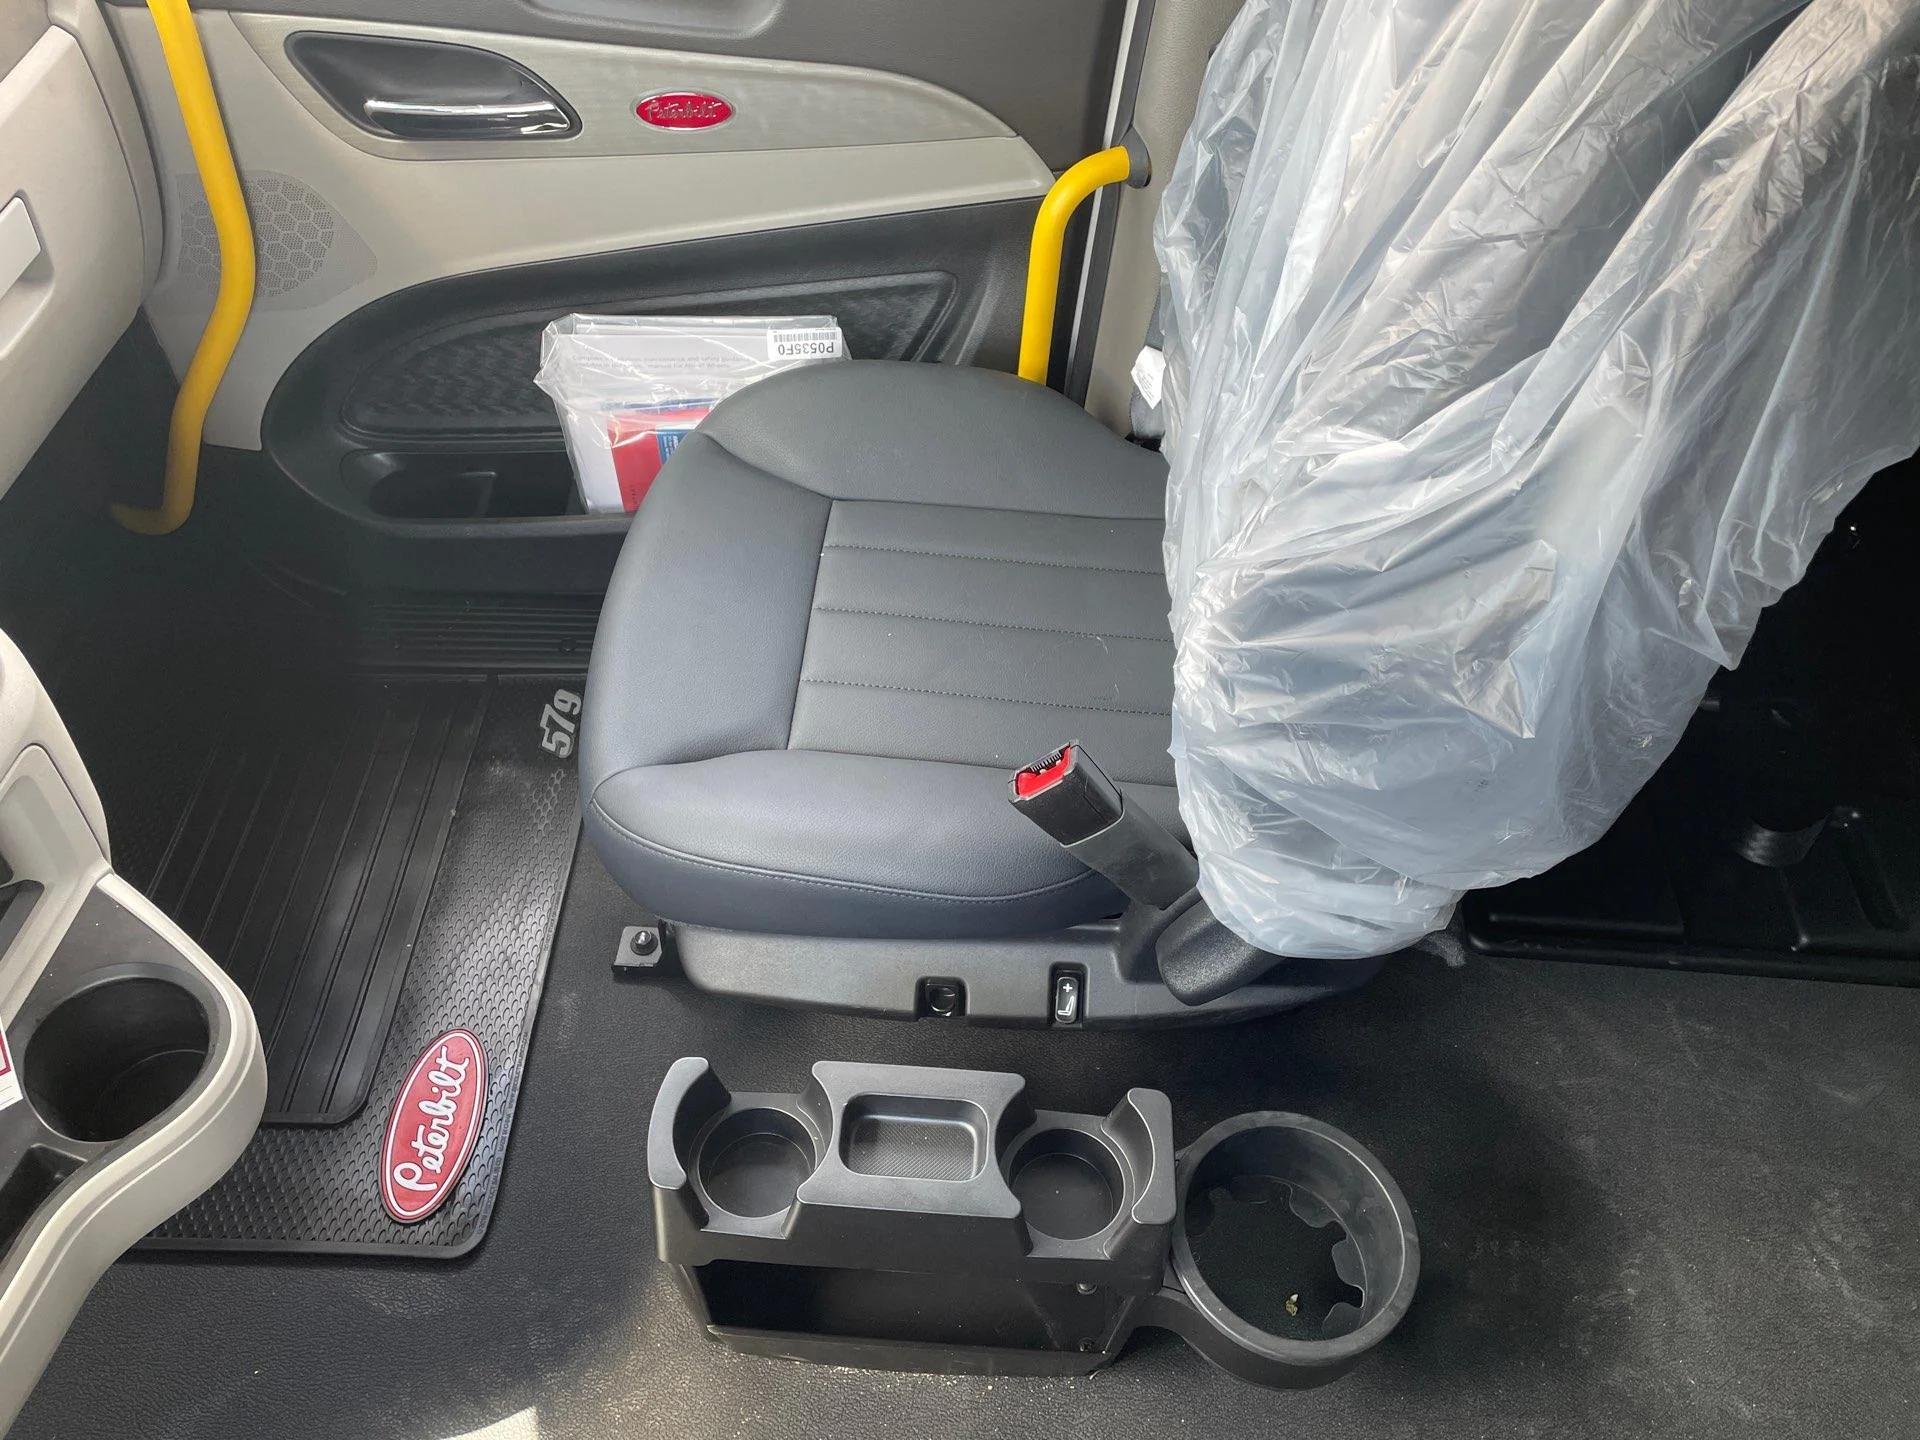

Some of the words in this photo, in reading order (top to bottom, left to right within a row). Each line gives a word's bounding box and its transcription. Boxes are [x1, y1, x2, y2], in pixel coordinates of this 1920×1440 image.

[777, 342, 834, 356] P0535F0
[540, 689, 582, 758] 579
[393, 1045, 470, 1192] Peterbilt
